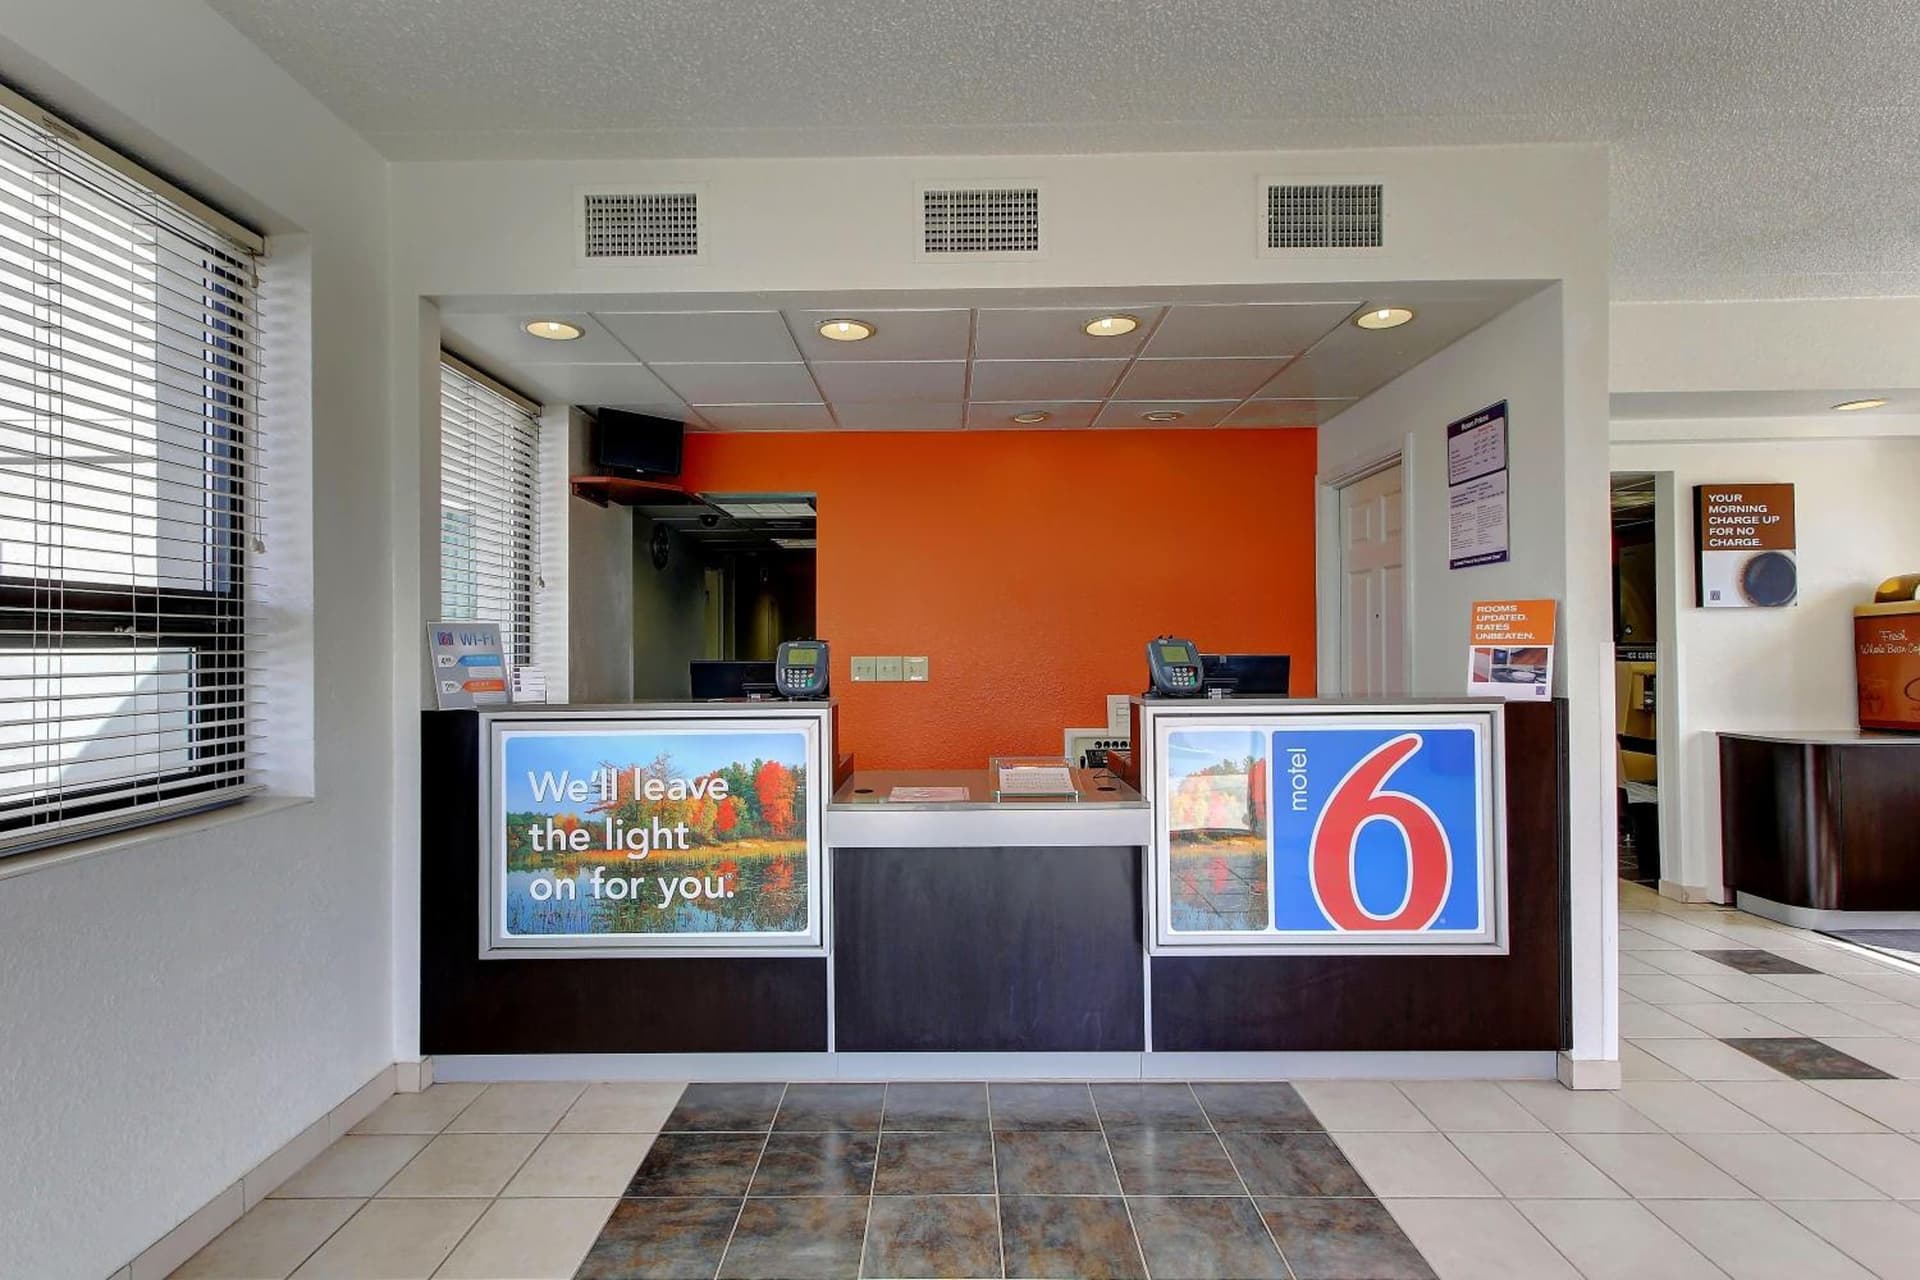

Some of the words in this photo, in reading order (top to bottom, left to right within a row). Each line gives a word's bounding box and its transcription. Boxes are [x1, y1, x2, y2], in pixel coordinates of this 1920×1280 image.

[1708, 493, 1743, 503] YOUR
[1708, 504, 1768, 514] MORNING
[1708, 516, 1760, 525] CHARGE
[1763, 515, 1780, 524] UP
[1709, 527, 1733, 536] FOR
[1736, 526, 1755, 536] NO
[1709, 538, 1763, 547] CHARGE.
[1476, 604, 1518, 613] ROOMS
[1476, 613, 1529, 622] UPDATED.
[1475, 623, 1510, 631] RATES
[1475, 632, 1536, 640] UNBEATEN.
[1879, 629, 1908, 641] Fresh
[1887, 642, 1907, 654] Bean
[528, 767, 619, 803] We'll
[634, 767, 730, 801] leave
[1287, 748, 1308, 812] motel
[1308, 732, 1453, 932] 6
[528, 817, 591, 852] the
[605, 816, 690, 860] light
[529, 876, 576, 901] on
[590, 866, 645, 900] for
[657, 874, 735, 909] you.
